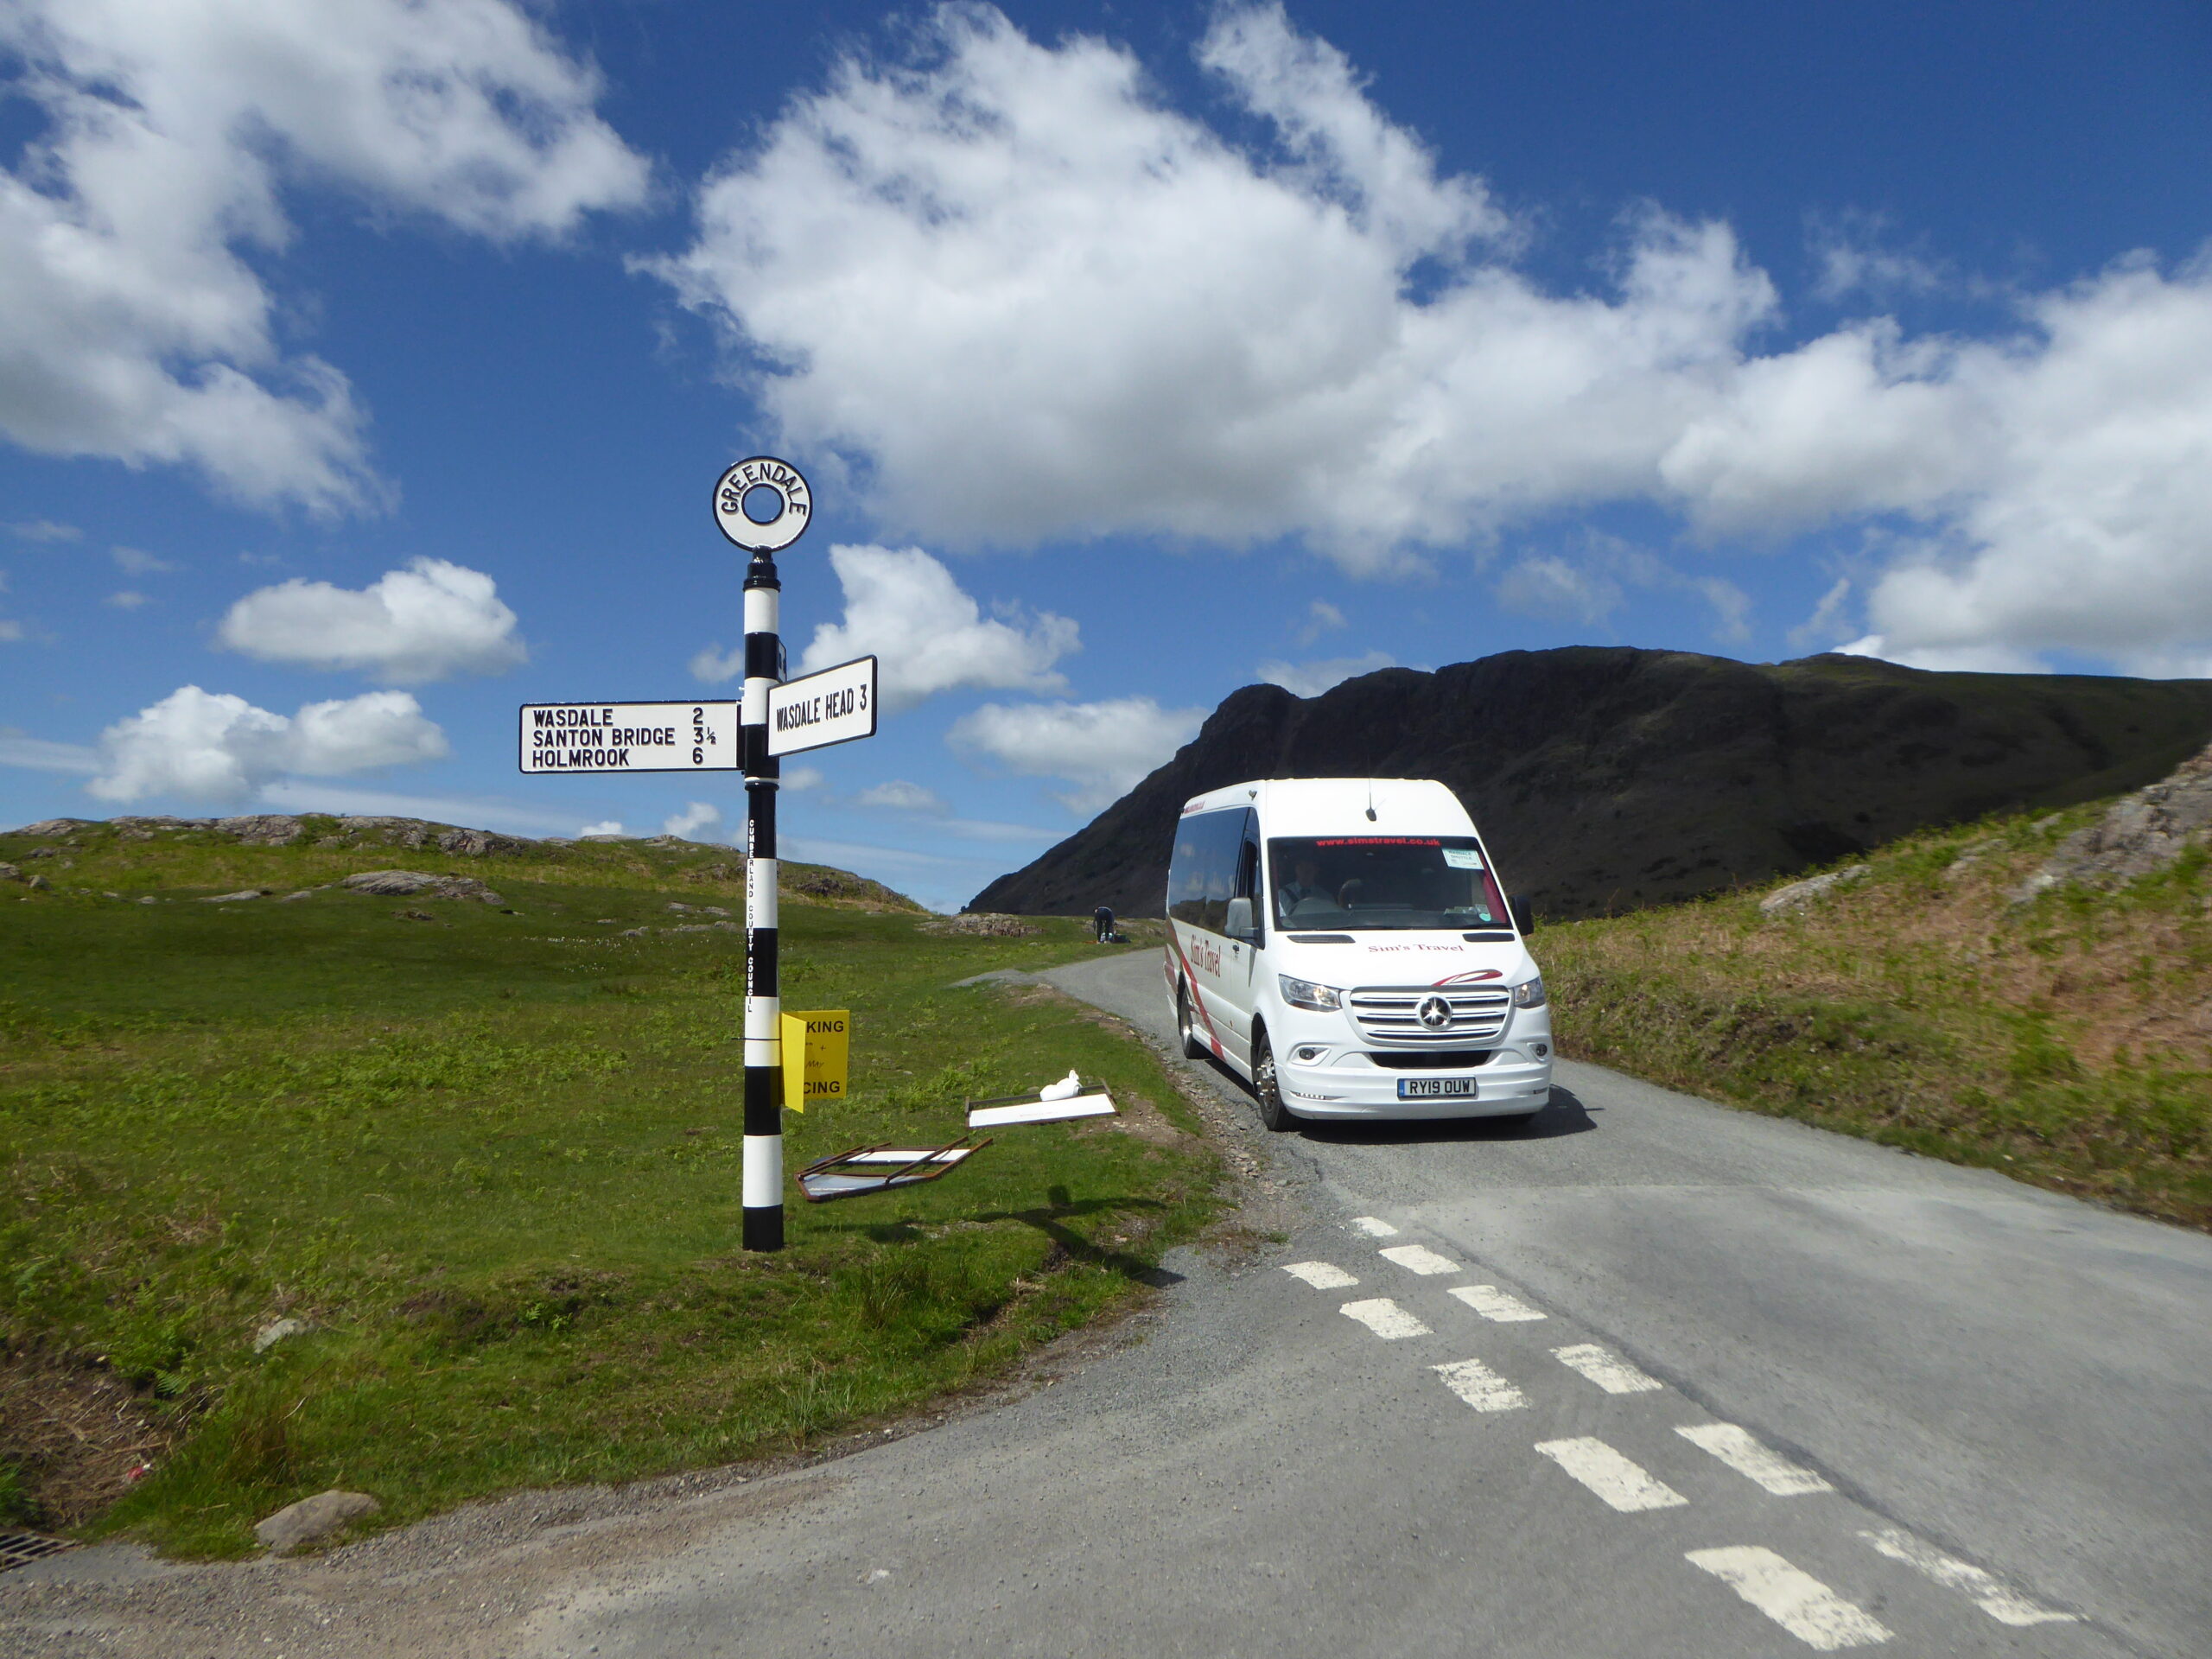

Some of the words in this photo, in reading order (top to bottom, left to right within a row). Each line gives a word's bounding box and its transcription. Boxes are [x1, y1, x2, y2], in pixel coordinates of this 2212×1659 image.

[721, 462, 807, 516] GREENDALE
[533, 709, 613, 728] WASDALE
[693, 707, 703, 725] 2
[776, 696, 821, 733] WASDALE
[825, 688, 854, 721] HEAD
[860, 683, 867, 711] 3
[533, 728, 603, 748] SANTON
[612, 728, 675, 746] BRIDGE
[532, 748, 629, 767] HOLMROOK
[692, 747, 703, 765] 6
[1205, 939, 1221, 977] Travel
[1409, 1081, 1440, 1094] RY19
[1445, 1080, 1470, 1093] OUW
